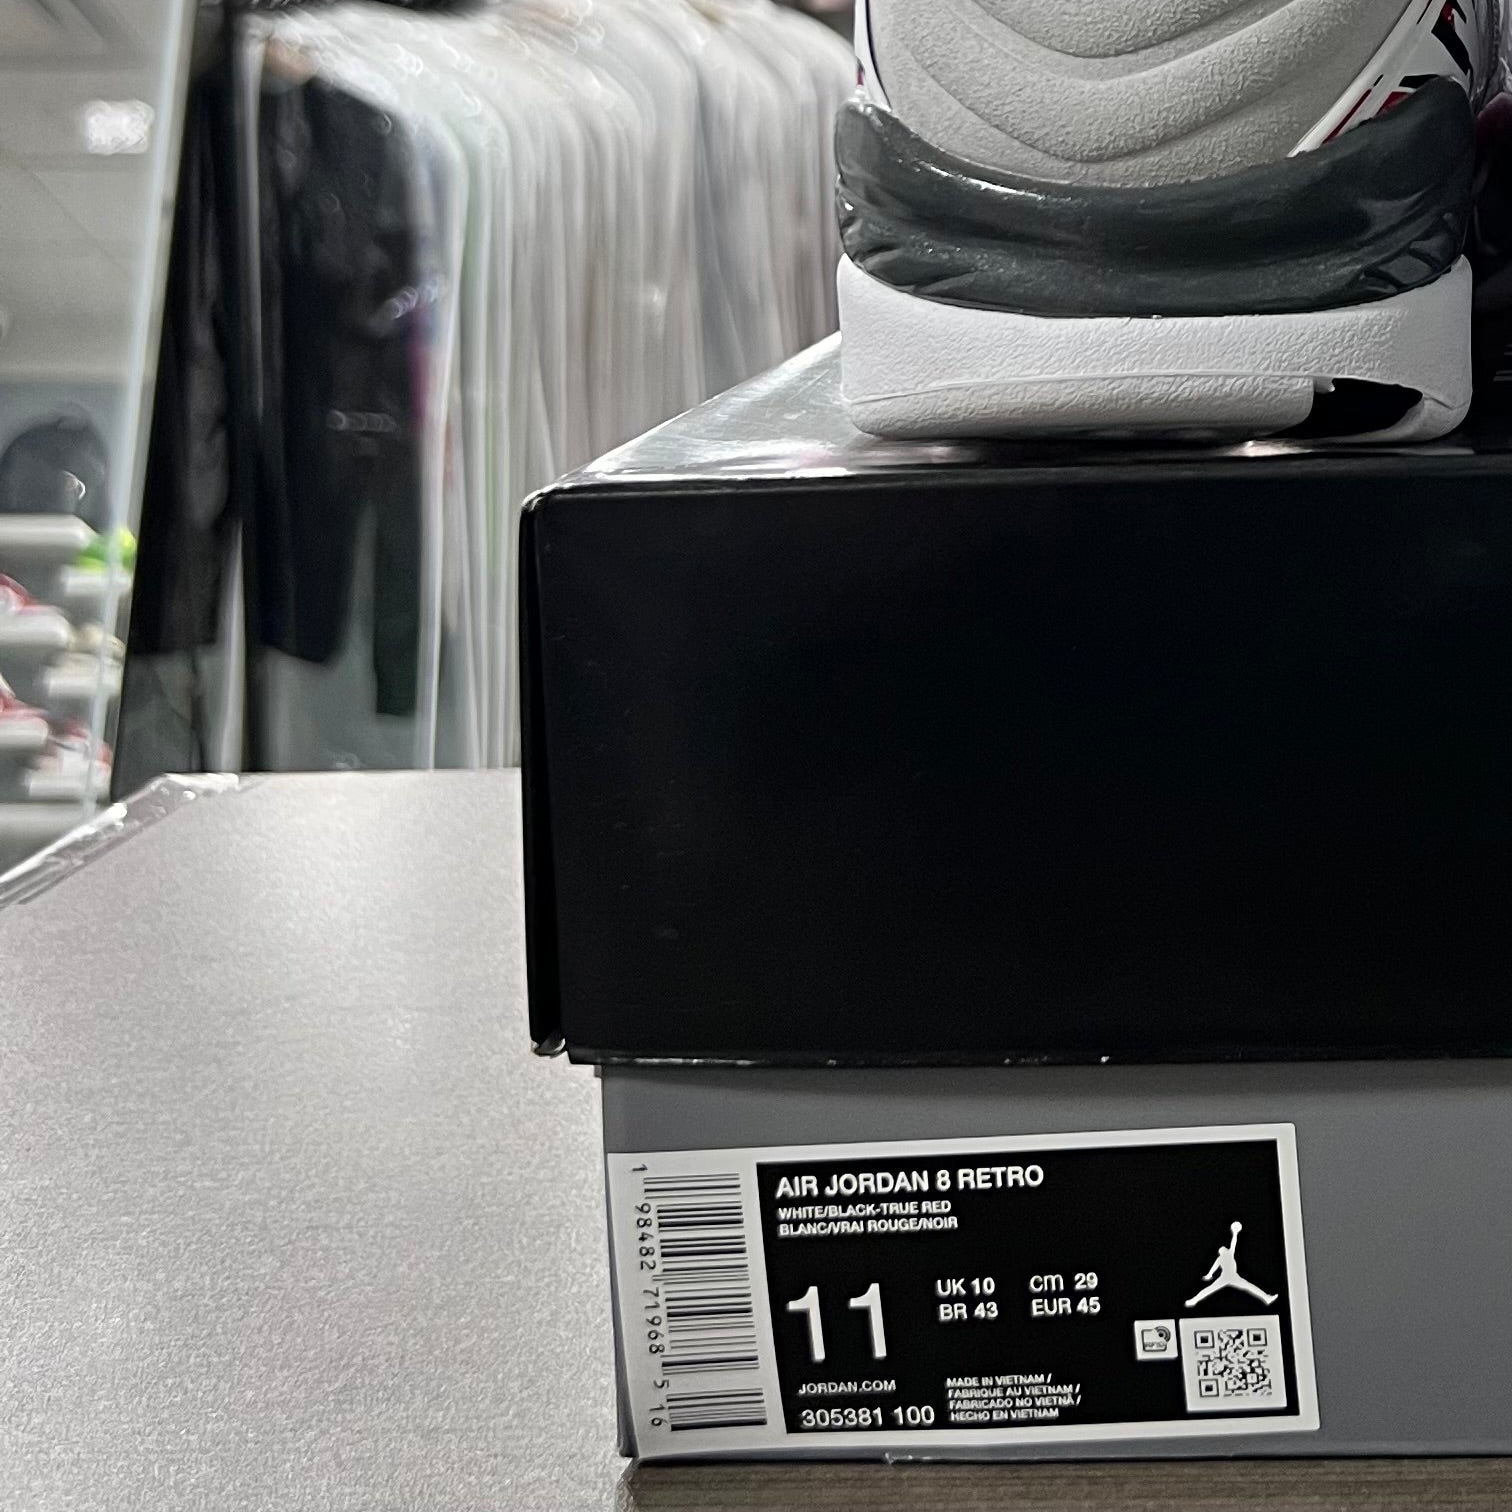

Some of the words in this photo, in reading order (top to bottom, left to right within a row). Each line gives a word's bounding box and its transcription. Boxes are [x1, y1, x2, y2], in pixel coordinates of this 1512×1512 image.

[776, 1175, 818, 1198] AIR
[824, 1170, 929, 1196] JORDAN
[936, 1170, 951, 1191] 8
[958, 1165, 1044, 1190] RETRO
[778, 1201, 919, 1220] WHITE/BLACK-TRUE
[921, 1200, 952, 1214] RED
[634, 1202, 657, 1271] 98482
[778, 1220, 864, 1237] BLANC/VRAI
[867, 1216, 958, 1233] ROUGE/NOIR
[936, 1278, 967, 1296] UK
[970, 1277, 995, 1295] 10
[1074, 1272, 1098, 1290] 29
[939, 1303, 968, 1322] BR
[973, 1301, 999, 1319] 43
[1031, 1297, 1072, 1317] EUR
[1076, 1296, 1101, 1315] 45
[643, 1287, 666, 1354] 71968
[786, 1283, 887, 1363] 11
[653, 1379, 670, 1390] 5
[799, 1379, 896, 1395] JORDAN.COM
[946, 1377, 979, 1388] MADE
[982, 1376, 993, 1386] IN
[995, 1374, 1044, 1386] VIETNAM
[948, 1387, 1003, 1399] FABRIQUE
[1005, 1386, 1021, 1396] AU
[1023, 1384, 1073, 1396] VIETNAM
[950, 1397, 1012, 1410] FABRICADO
[1015, 1397, 1032, 1407] NO
[649, 1403, 669, 1427] 16
[801, 1407, 883, 1427] 305381
[893, 1405, 935, 1426] 100
[951, 1409, 990, 1421] HECHO
[992, 1409, 1008, 1420] EN
[1009, 1408, 1059, 1420] VIETNAM
